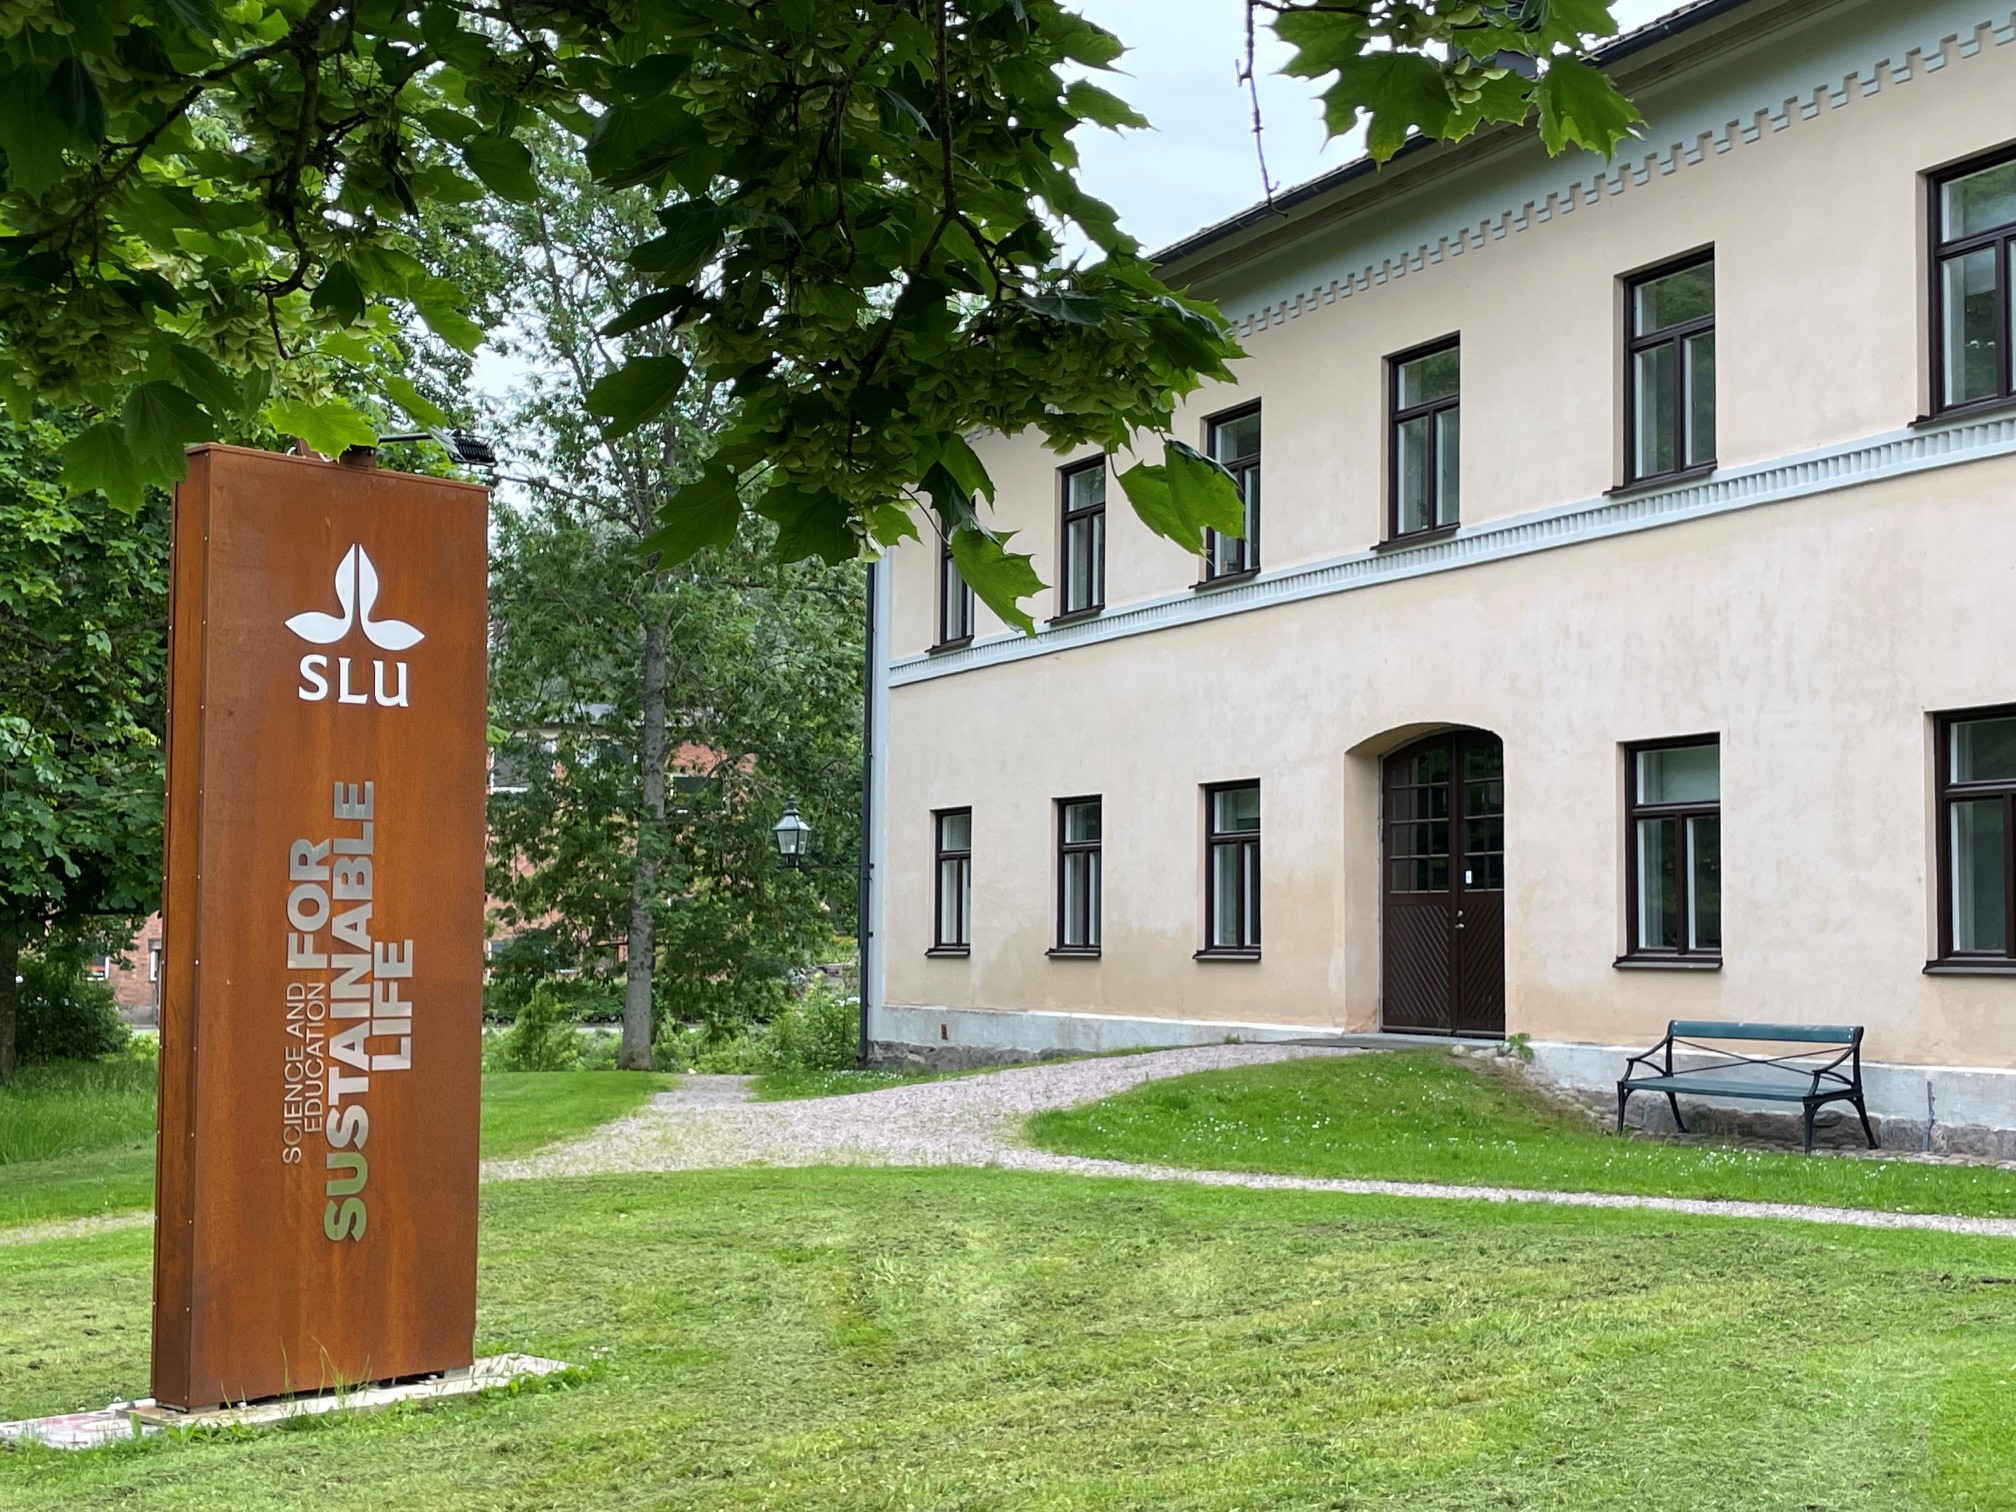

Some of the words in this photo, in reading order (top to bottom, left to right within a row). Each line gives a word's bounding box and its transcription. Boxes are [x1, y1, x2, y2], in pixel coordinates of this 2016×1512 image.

[298, 654, 408, 707] SLU
[287, 838, 330, 969] FOR
[285, 982, 305, 1039] AND
[304, 982, 325, 1133] EDUCATION
[324, 781, 374, 1242] SUSTAINABLE
[372, 939, 413, 1070] LIFE
[282, 1046, 304, 1164] SCIENCE
